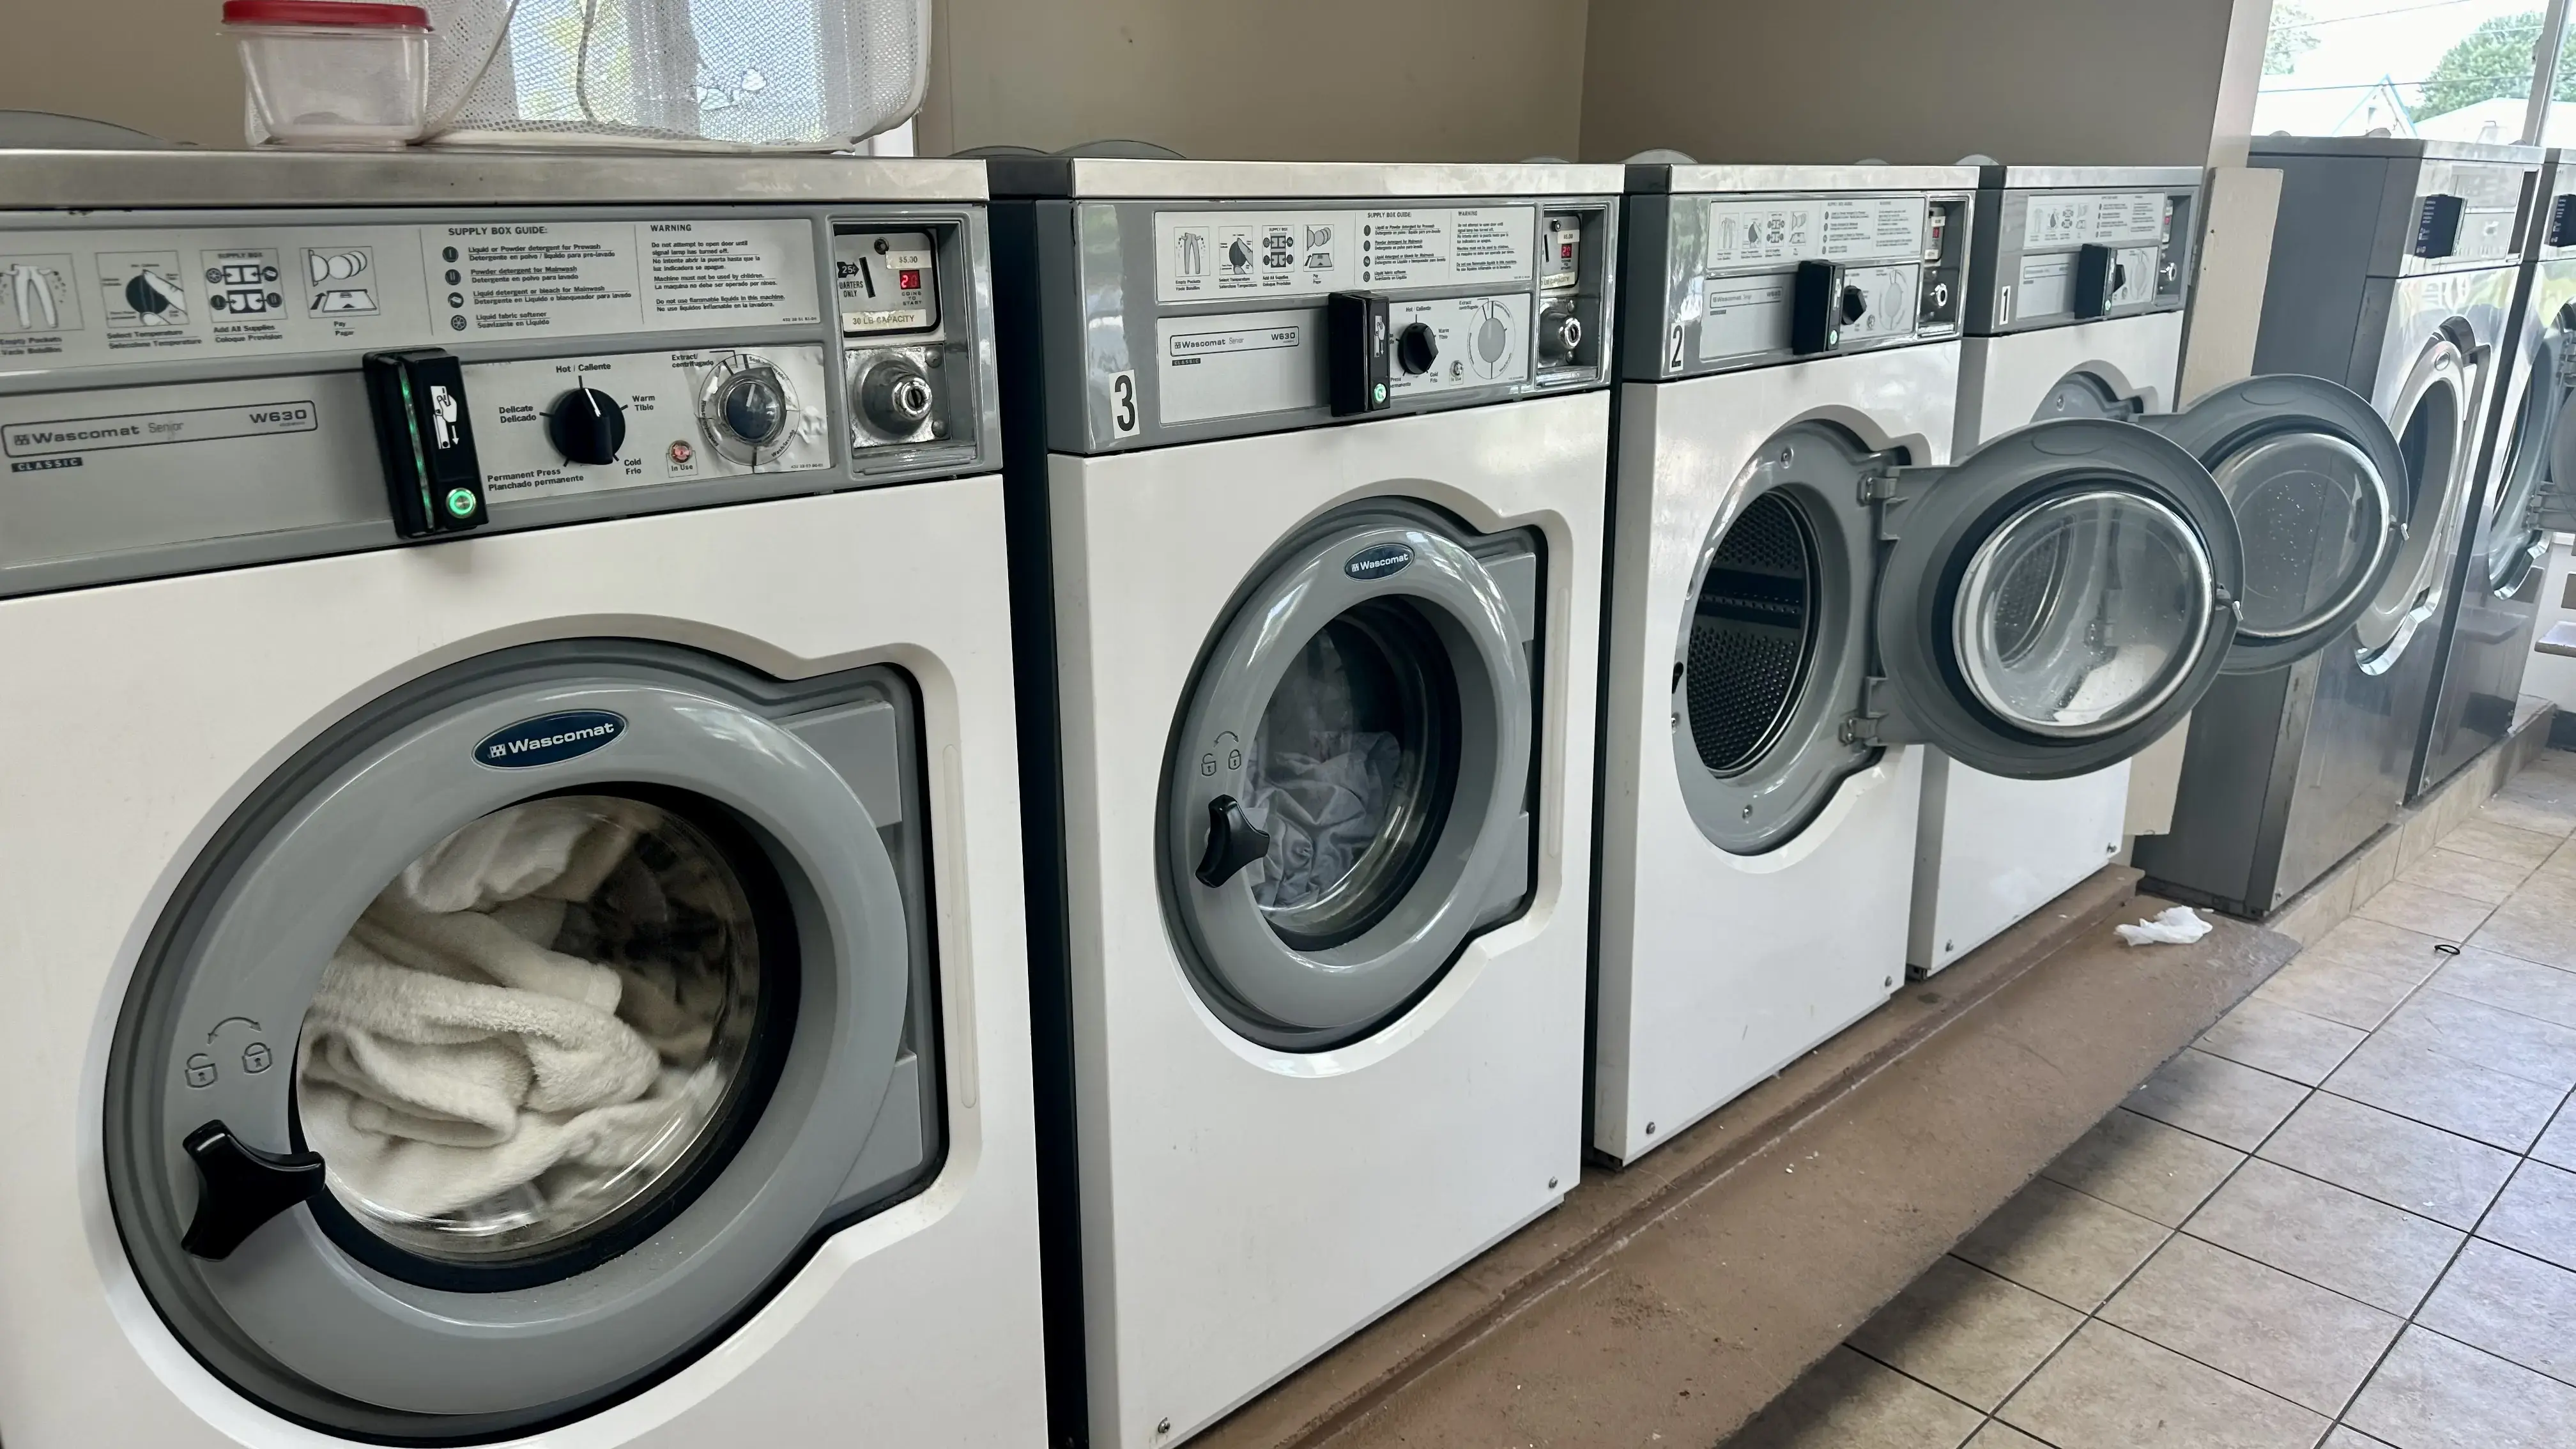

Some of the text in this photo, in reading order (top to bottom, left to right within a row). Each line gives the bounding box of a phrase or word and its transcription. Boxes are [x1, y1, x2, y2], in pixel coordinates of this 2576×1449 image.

[448, 227, 487, 235] SUPPLY
[515, 226, 548, 234] GUIDE:
[2004, 288, 2009, 321] 1
[877, 314, 915, 323] CAPACITY
[1182, 339, 1225, 348] Wascomat
[1271, 332, 1296, 341] W630
[1672, 325, 1683, 367] 2
[556, 363, 611, 373] Hot Caliente
[632, 394, 655, 402] Warm
[1114, 374, 1135, 431] 3
[499, 405, 533, 414] Delicate
[32, 425, 141, 444] Wascomat
[250, 409, 307, 424] W630
[500, 414, 537, 424] Delicado
[18, 459, 77, 470] CLASSIC
[487, 468, 561, 482] Permanent Press
[488, 475, 584, 491] Planchado permanente
[1360, 553, 1408, 571] Wascomat
[508, 723, 615, 754] Wascomat
